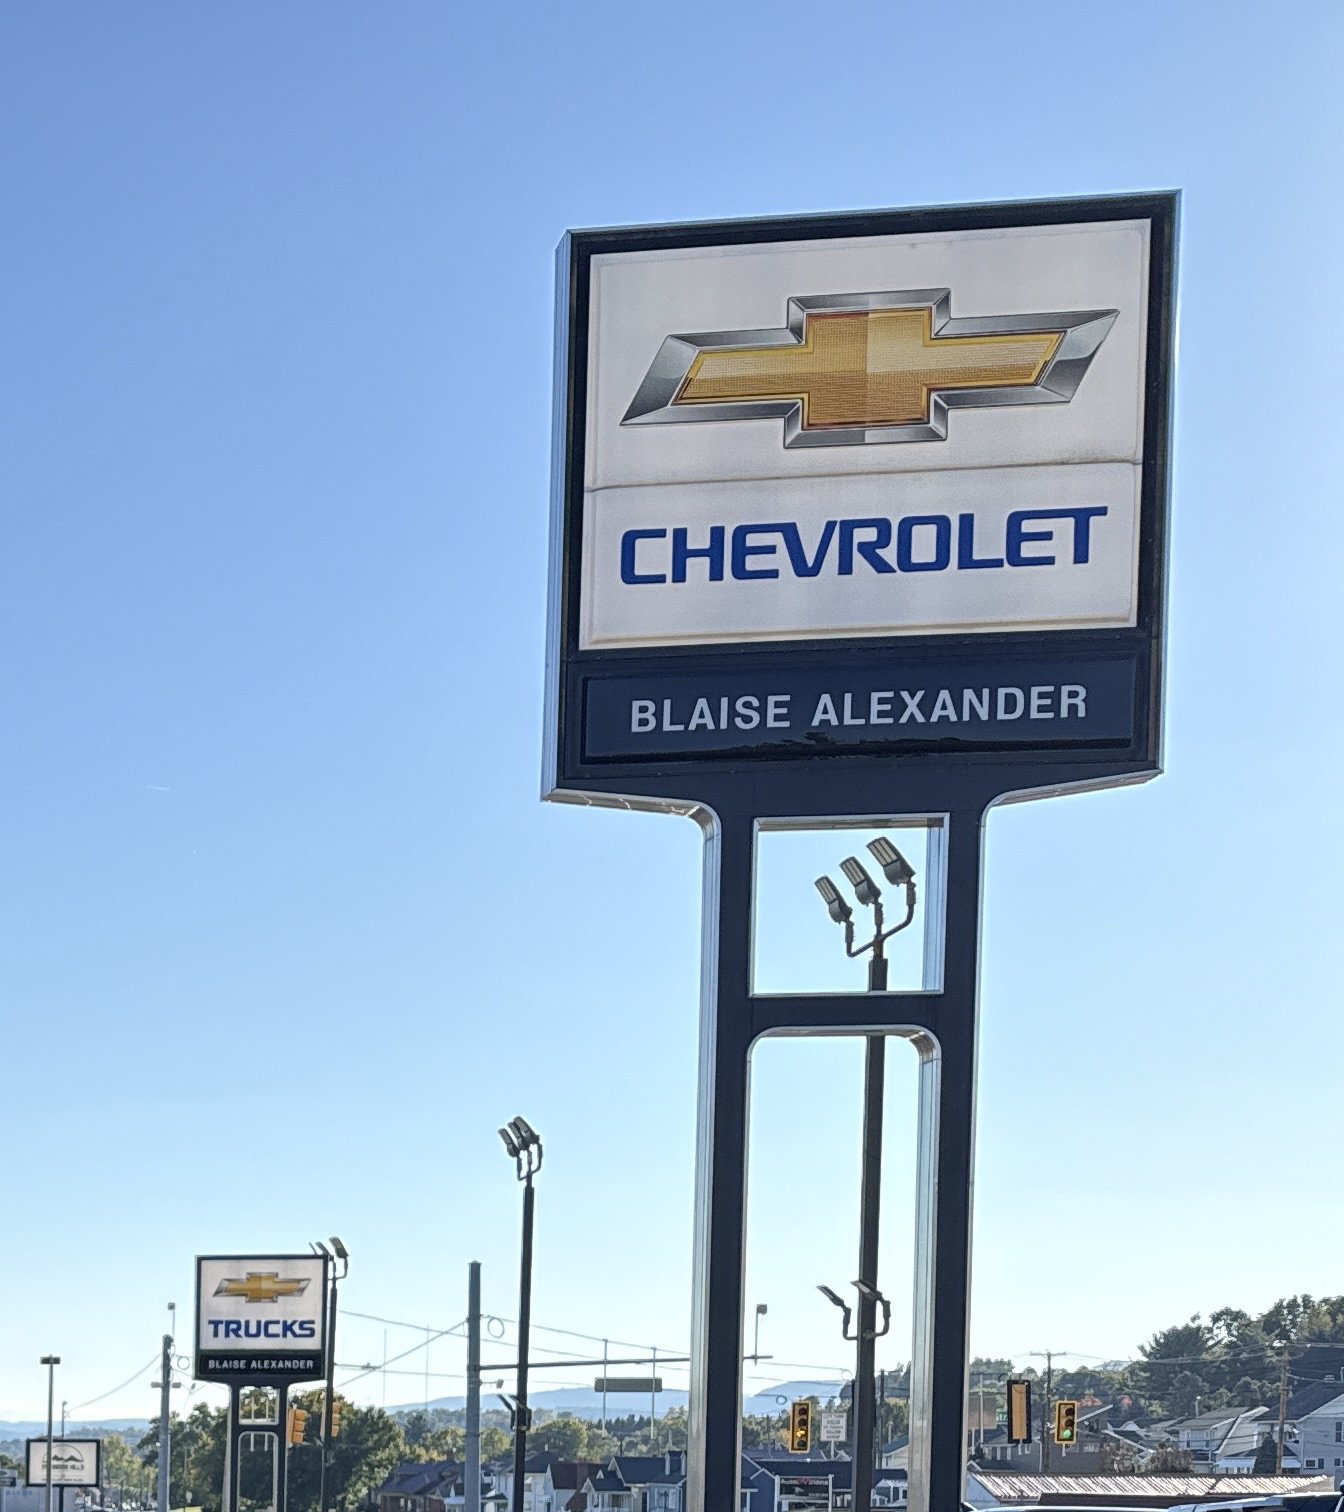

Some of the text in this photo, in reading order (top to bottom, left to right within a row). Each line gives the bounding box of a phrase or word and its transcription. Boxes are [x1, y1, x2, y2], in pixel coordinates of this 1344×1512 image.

[620, 505, 1109, 585] CHEVROLET
[630, 684, 1088, 734] BLAISE ALEXANDER
[207, 1319, 316, 1338] TRUCKS
[208, 1359, 314, 1369] BLAISE ALEXANDER
